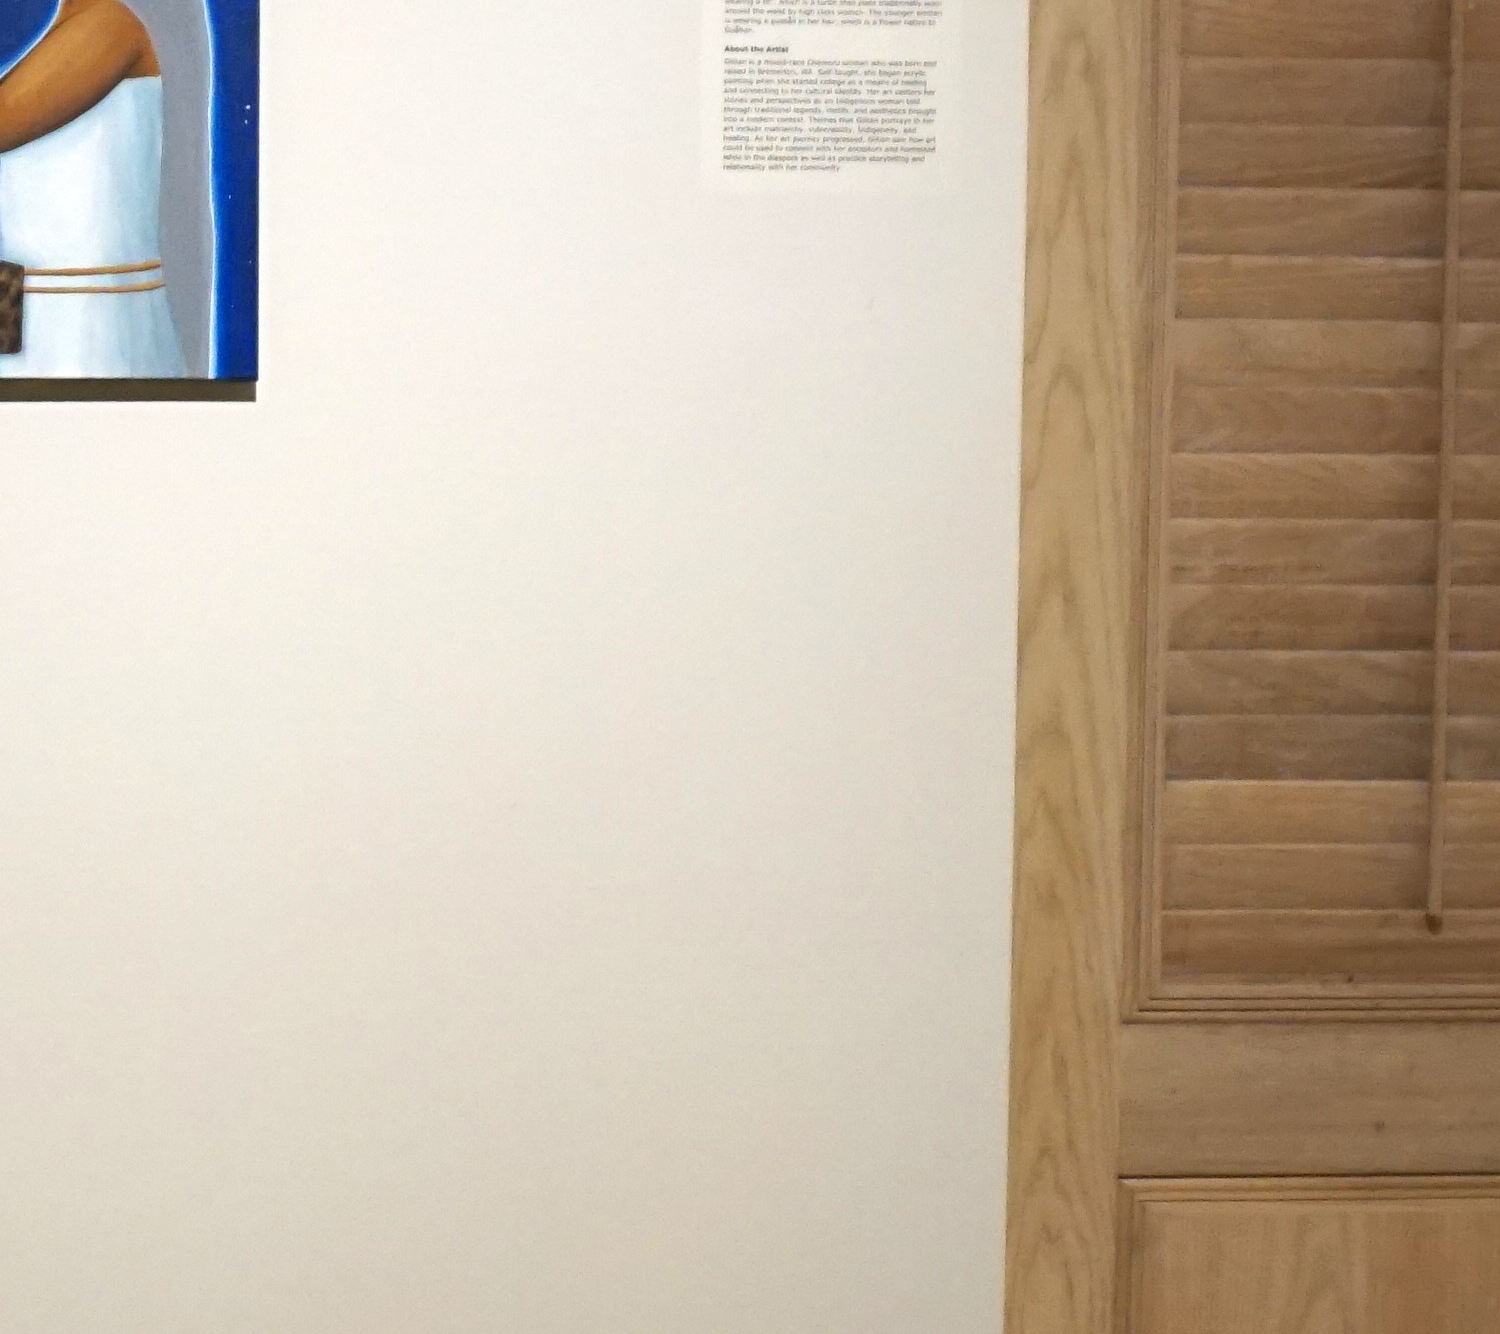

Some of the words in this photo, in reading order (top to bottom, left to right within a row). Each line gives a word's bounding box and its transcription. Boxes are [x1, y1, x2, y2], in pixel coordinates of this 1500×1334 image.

[725, 44, 748, 53] About
[750, 44, 764, 53] the
[766, 44, 789, 53] Artist
